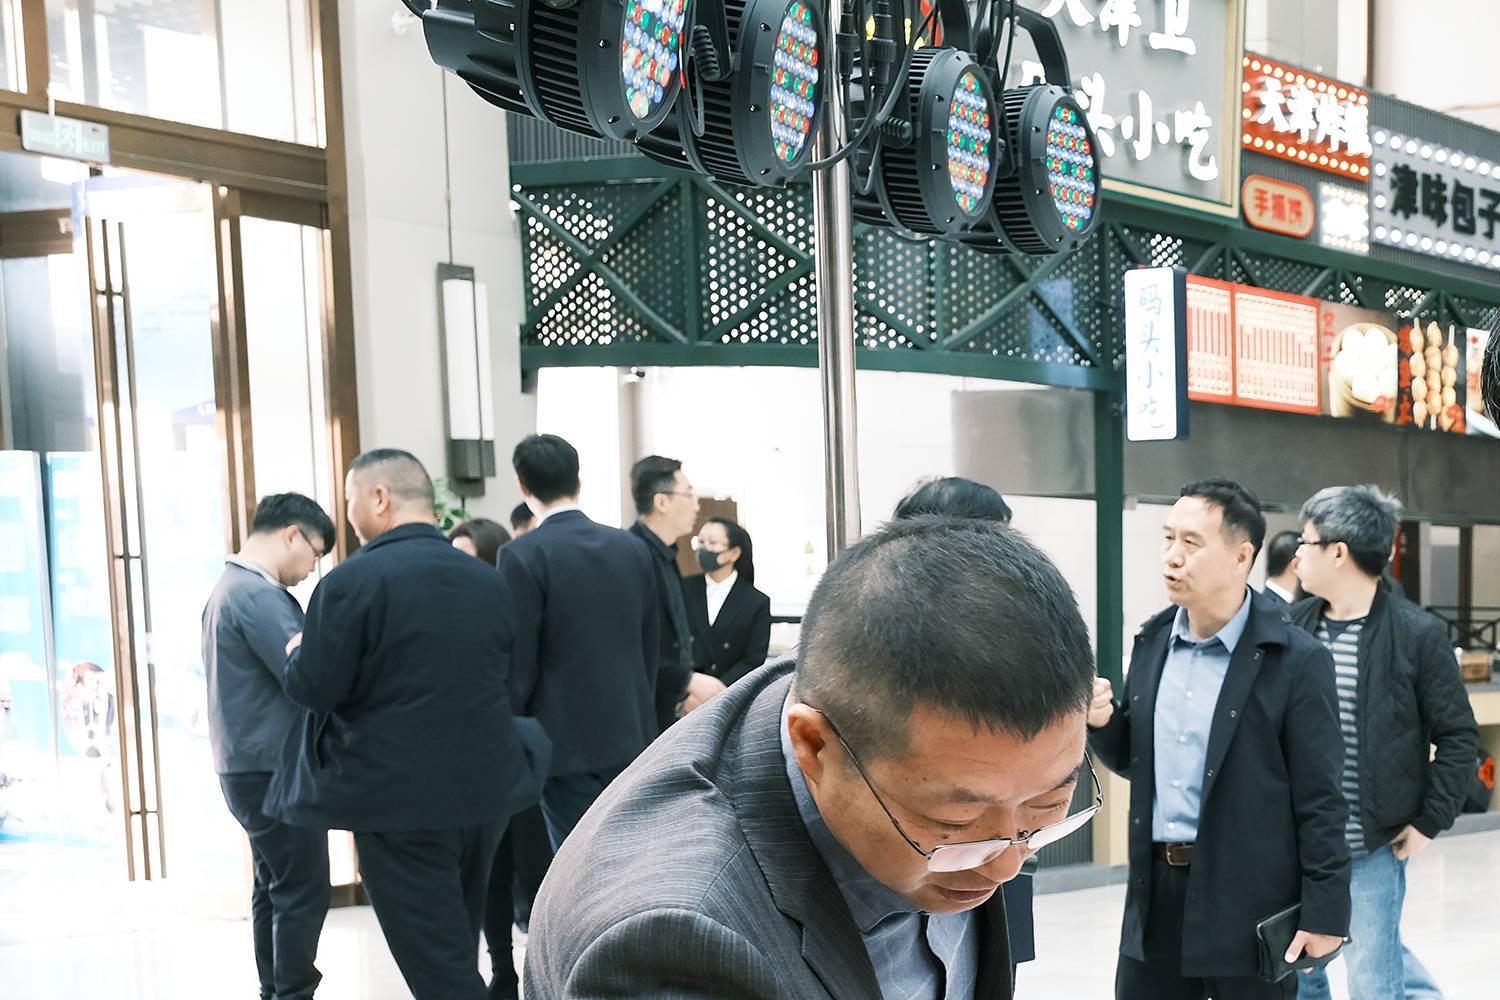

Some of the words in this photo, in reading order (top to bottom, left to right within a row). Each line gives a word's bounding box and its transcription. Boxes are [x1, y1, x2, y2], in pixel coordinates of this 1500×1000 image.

[1022, 60, 1219, 181] 头小吃
[1137, 282, 1166, 430] 码头小吃
